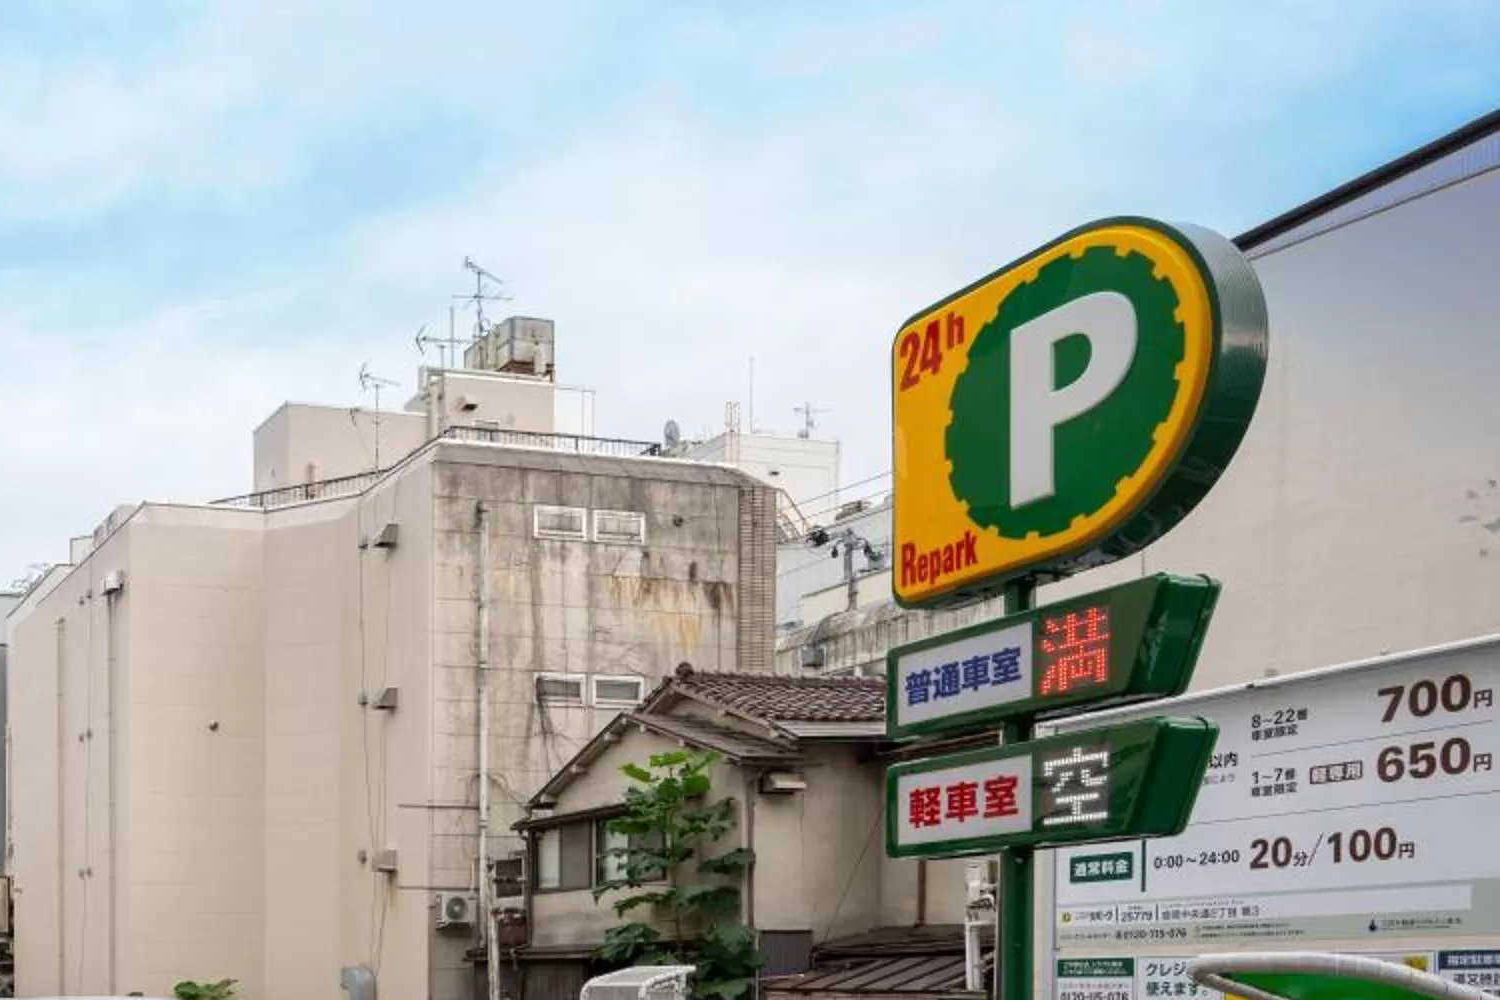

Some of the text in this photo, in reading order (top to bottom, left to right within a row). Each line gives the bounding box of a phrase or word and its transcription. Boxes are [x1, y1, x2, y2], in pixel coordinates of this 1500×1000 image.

[900, 312, 965, 391] 24h
[1009, 291, 1139, 511] P
[901, 530, 978, 588] Repark
[905, 646, 1022, 706] 普通車室
[1040, 606, 1111, 696] 満
[1377, 673, 1494, 723] 700円
[1042, 747, 1109, 825] 空
[1376, 737, 1493, 783] 650円
[909, 775, 1020, 829] 軽車室
[1074, 859, 1129, 877] 通常料金
[1145, 962, 1192, 978] クレジ
